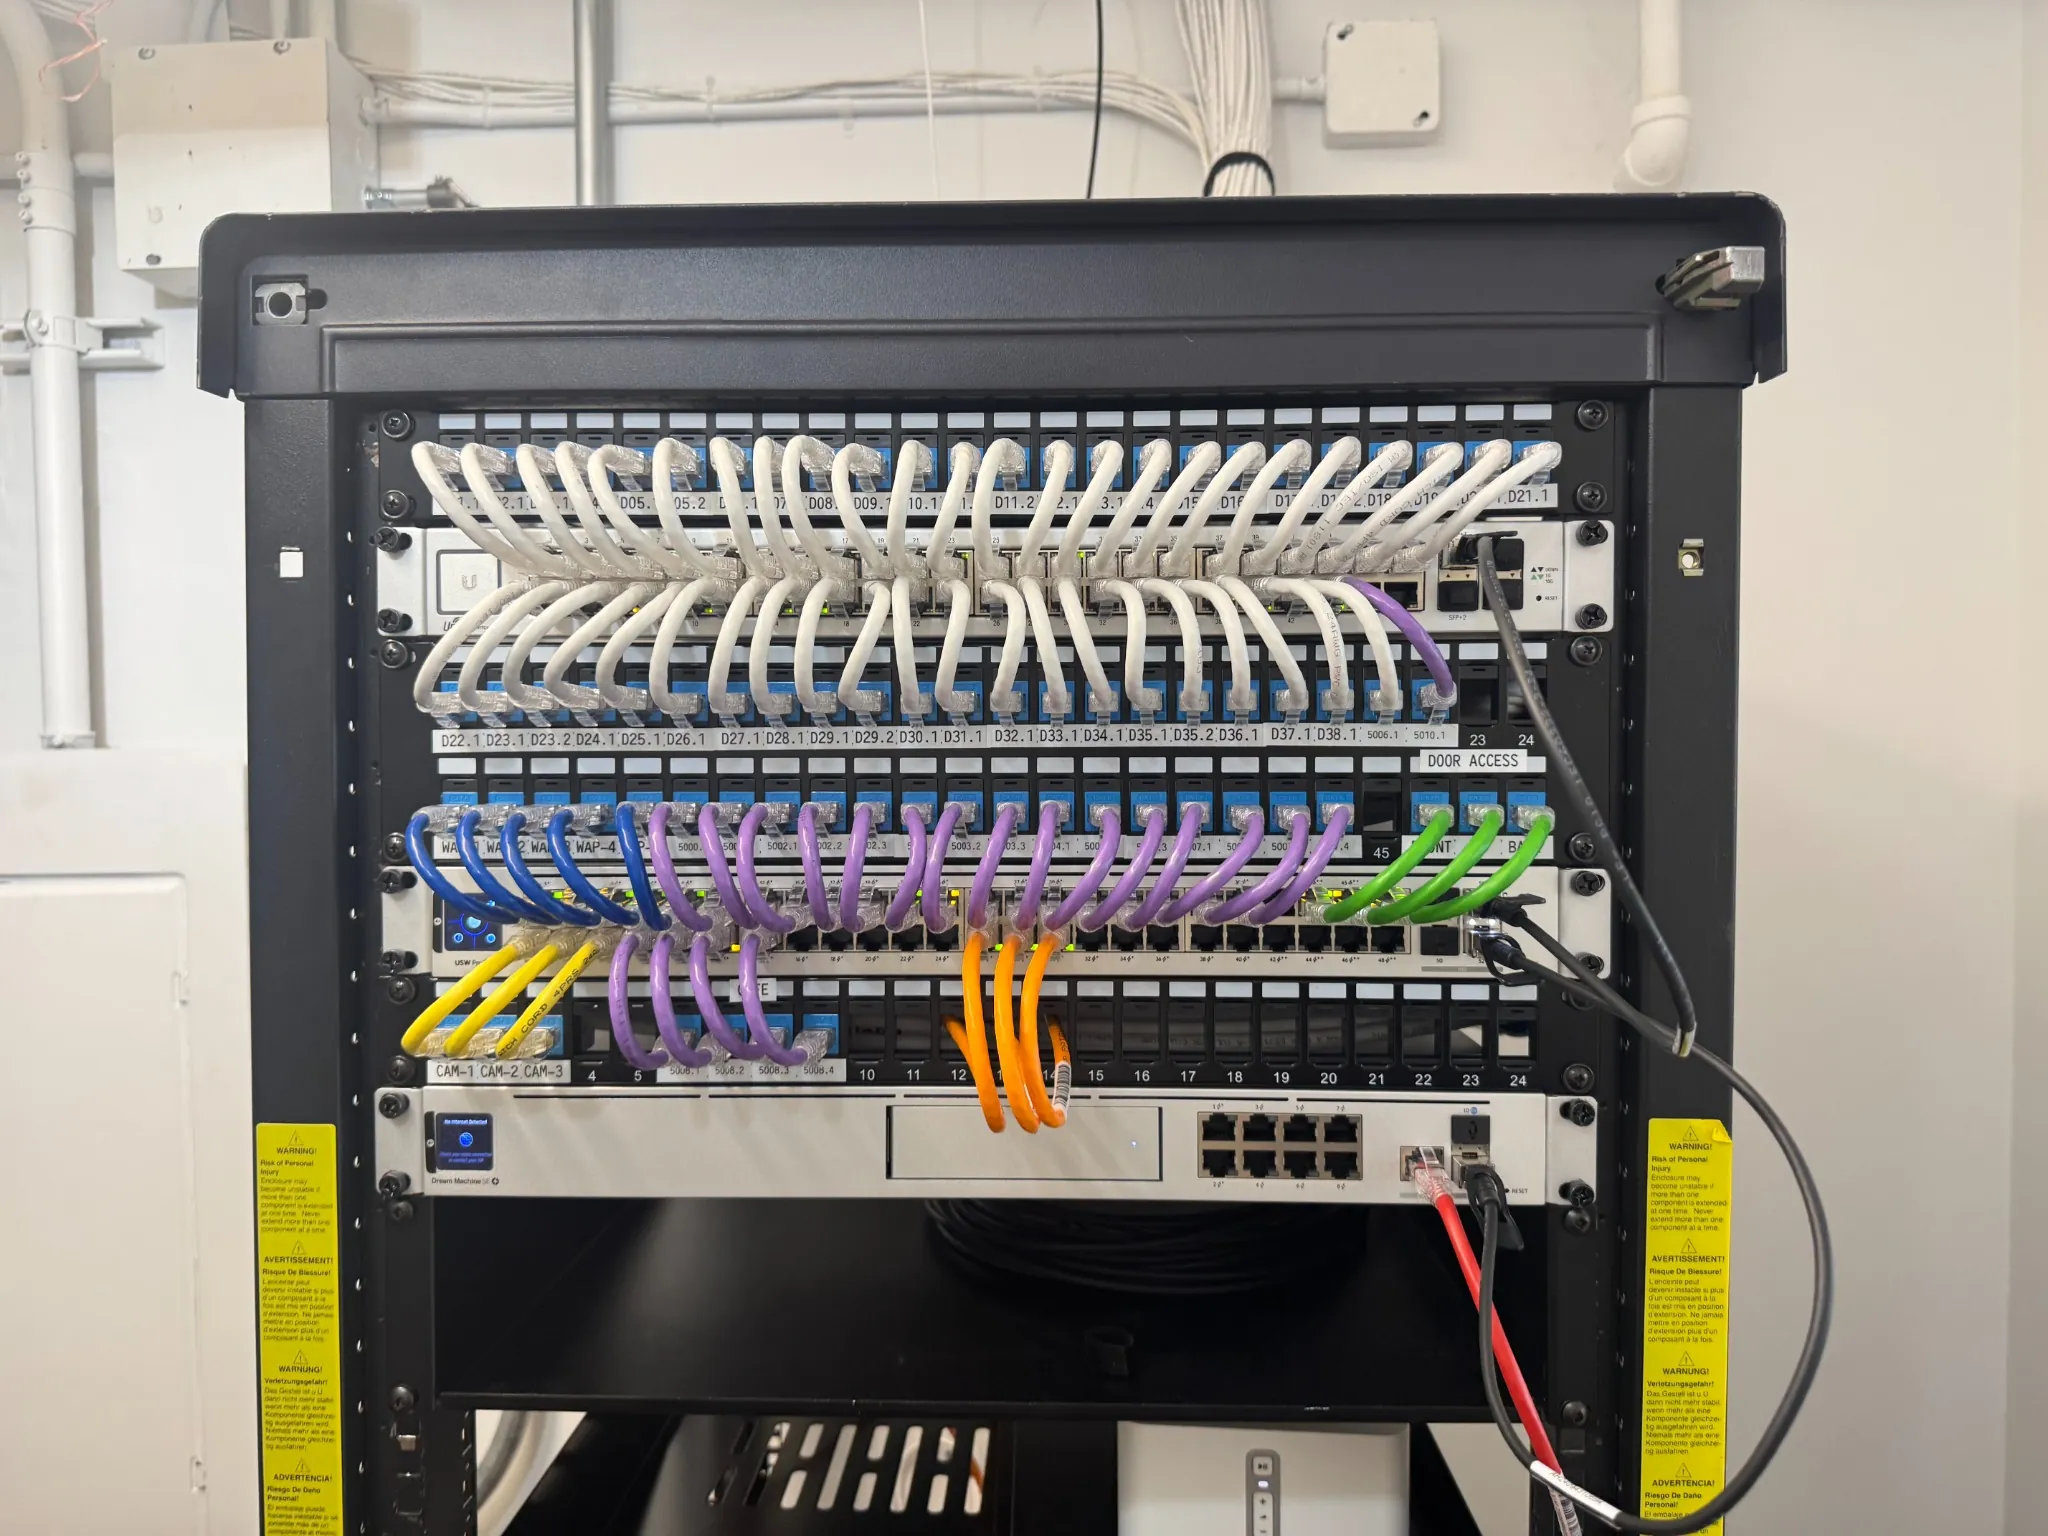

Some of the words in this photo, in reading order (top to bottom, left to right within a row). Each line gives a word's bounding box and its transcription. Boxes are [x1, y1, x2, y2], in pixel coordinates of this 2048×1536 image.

[620, 496, 650, 509] D05.
[675, 496, 706, 509] 05.2
[809, 496, 839, 509] D08.
[908, 496, 937, 510] 10.1
[995, 495, 1034, 509] D11.2
[1508, 488, 1548, 503] D21.1
[442, 734, 480, 747] D22.1
[486, 733, 524, 747] D23.1
[531, 733, 571, 747] D23.2
[576, 733, 615, 747] D24.1
[621, 733, 660, 746] D25.1
[667, 733, 705, 746] D26.1
[721, 733, 760, 746] D27.1
[766, 731, 803, 745] D28.1
[810, 731, 849, 744] D29.1
[855, 731, 894, 744] D29.2
[899, 730, 938, 744] D30.1
[944, 730, 981, 743] D31.1
[995, 730, 1033, 743] D32.1
[1039, 730, 1077, 742] D33.1
[1084, 729, 1122, 742] D34.1
[1128, 729, 1167, 742] D35.1
[1174, 728, 1213, 741] D35.2
[1219, 728, 1258, 741] D36.1
[1271, 728, 1311, 741] D37.1
[1317, 728, 1357, 741] D38.1
[1367, 730, 1398, 740] 5006.1
[1413, 731, 1445, 740] 5010.1
[1469, 734, 1486, 746] 23
[1518, 734, 1534, 746] 24
[1427, 755, 1464, 768] DOOR
[1470, 755, 1519, 768] ACCESS
[486, 840, 525, 853] WA2
[531, 840, 571, 853] WA3
[576, 840, 616, 853] WAP-4
[678, 842, 703, 851] 5000.
[767, 842, 797, 851] 5002.1
[818, 842, 842, 850] 002.2
[951, 841, 981, 850] 5003.2
[1373, 847, 1390, 859] 45
[521, 1003, 548, 1034] CORD
[436, 1065, 474, 1078] CAM-1
[480, 1065, 519, 1078] CAM-2
[524, 1065, 563, 1078] CAM-3
[588, 1070, 597, 1081] 4
[633, 1070, 642, 1081] 5
[859, 1069, 876, 1081] 10
[907, 1069, 921, 1081] 11
[951, 1069, 967, 1081] 12
[1088, 1069, 1104, 1081] 15
[1134, 1070, 1151, 1082] 16
[1180, 1070, 1196, 1082] 17
[1227, 1071, 1243, 1083] 18
[1274, 1071, 1290, 1084] 19
[1320, 1072, 1337, 1085] 20
[1368, 1073, 1384, 1085] 21
[1415, 1073, 1432, 1086] 22
[1463, 1074, 1480, 1086] 23
[1510, 1075, 1527, 1087] 24
[277, 1147, 317, 1155] WARNING!
[1669, 1143, 1712, 1151] WARNING!
[1651, 1155, 1667, 1163] Risk
[1651, 1165, 1671, 1173] Injury
[264, 1256, 334, 1264] AVERTISSEMENT!
[1652, 1255, 1725, 1263] AVERTISSEMENT!
[1649, 1268, 1675, 1276] Risque
[278, 1365, 322, 1373] WARNUNG!
[1662, 1367, 1710, 1375] WARNUNG!
[1647, 1380, 1714, 1388] Verletzungsgefahr!
[1652, 1479, 1715, 1487] ADVERTENCIA!
